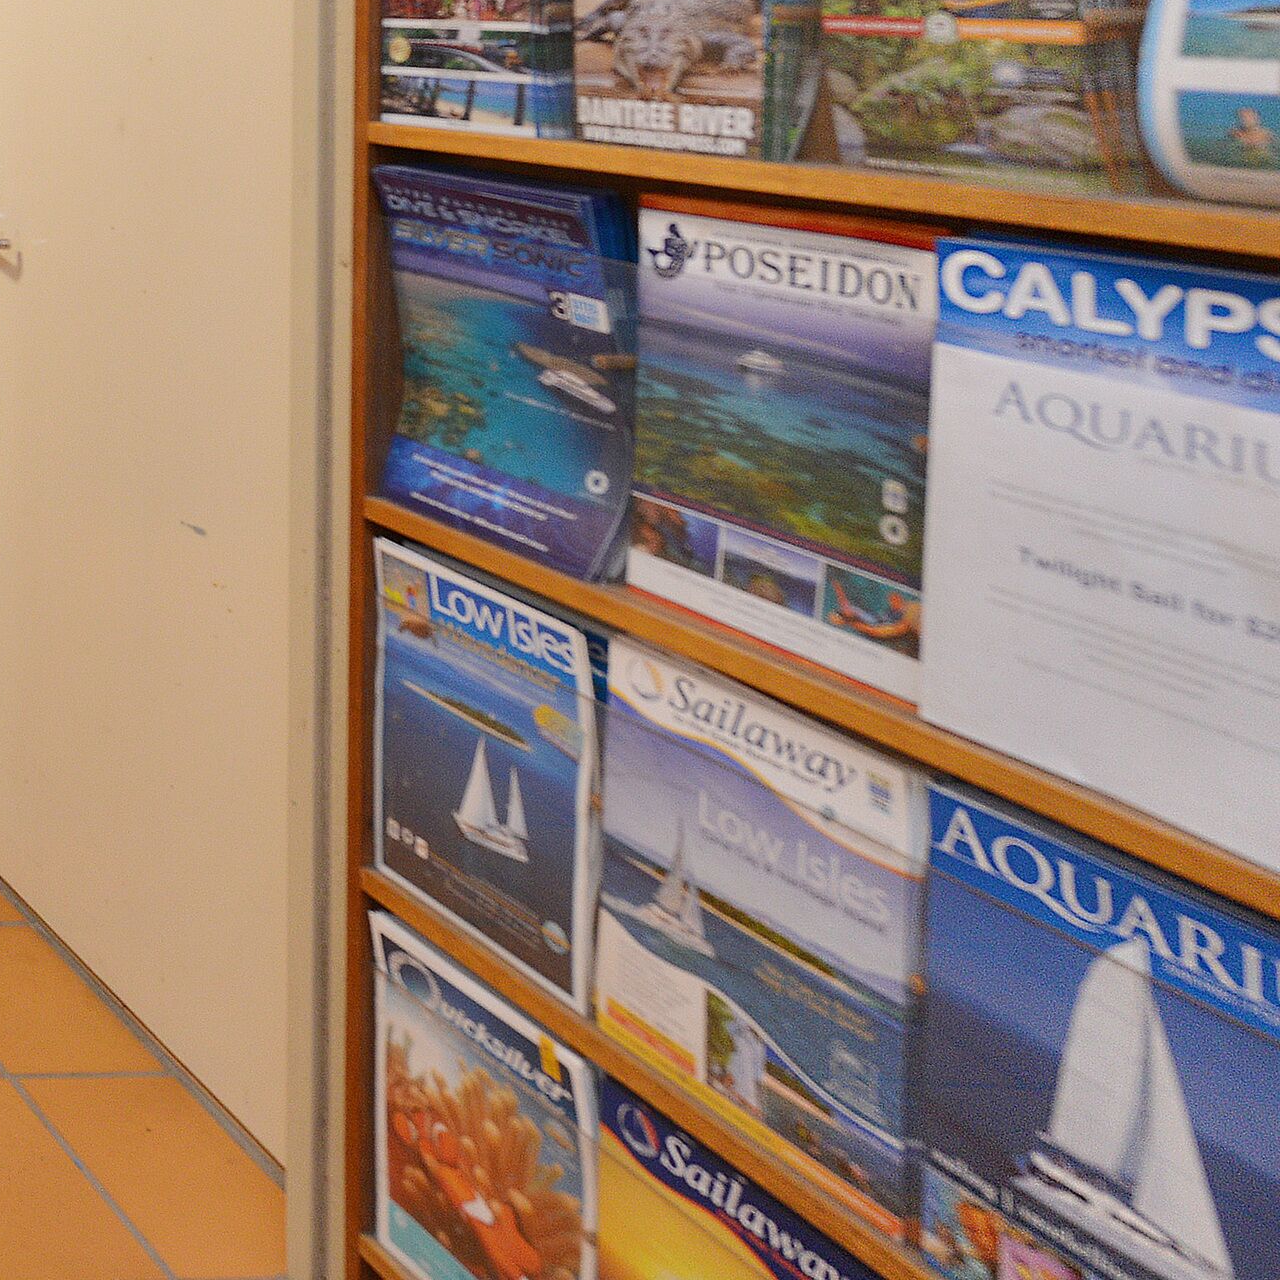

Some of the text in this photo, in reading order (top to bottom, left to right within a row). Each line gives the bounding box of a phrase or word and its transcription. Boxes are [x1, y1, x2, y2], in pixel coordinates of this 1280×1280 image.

[577, 94, 675, 133] DAINTREE
[678, 102, 755, 141] RIVER
[549, 291, 572, 322] 3
[704, 238, 920, 311] POSEIDON
[429, 572, 579, 677] Low Isles
[1019, 544, 1122, 593] Twilight
[1129, 579, 1185, 612] Sail
[668, 675, 857, 793] Sailaway
[698, 786, 784, 863] Low
[797, 840, 890, 918] Isles
[940, 808, 1280, 1008] AQUARI
[389, 950, 575, 1102] Quicksilver
